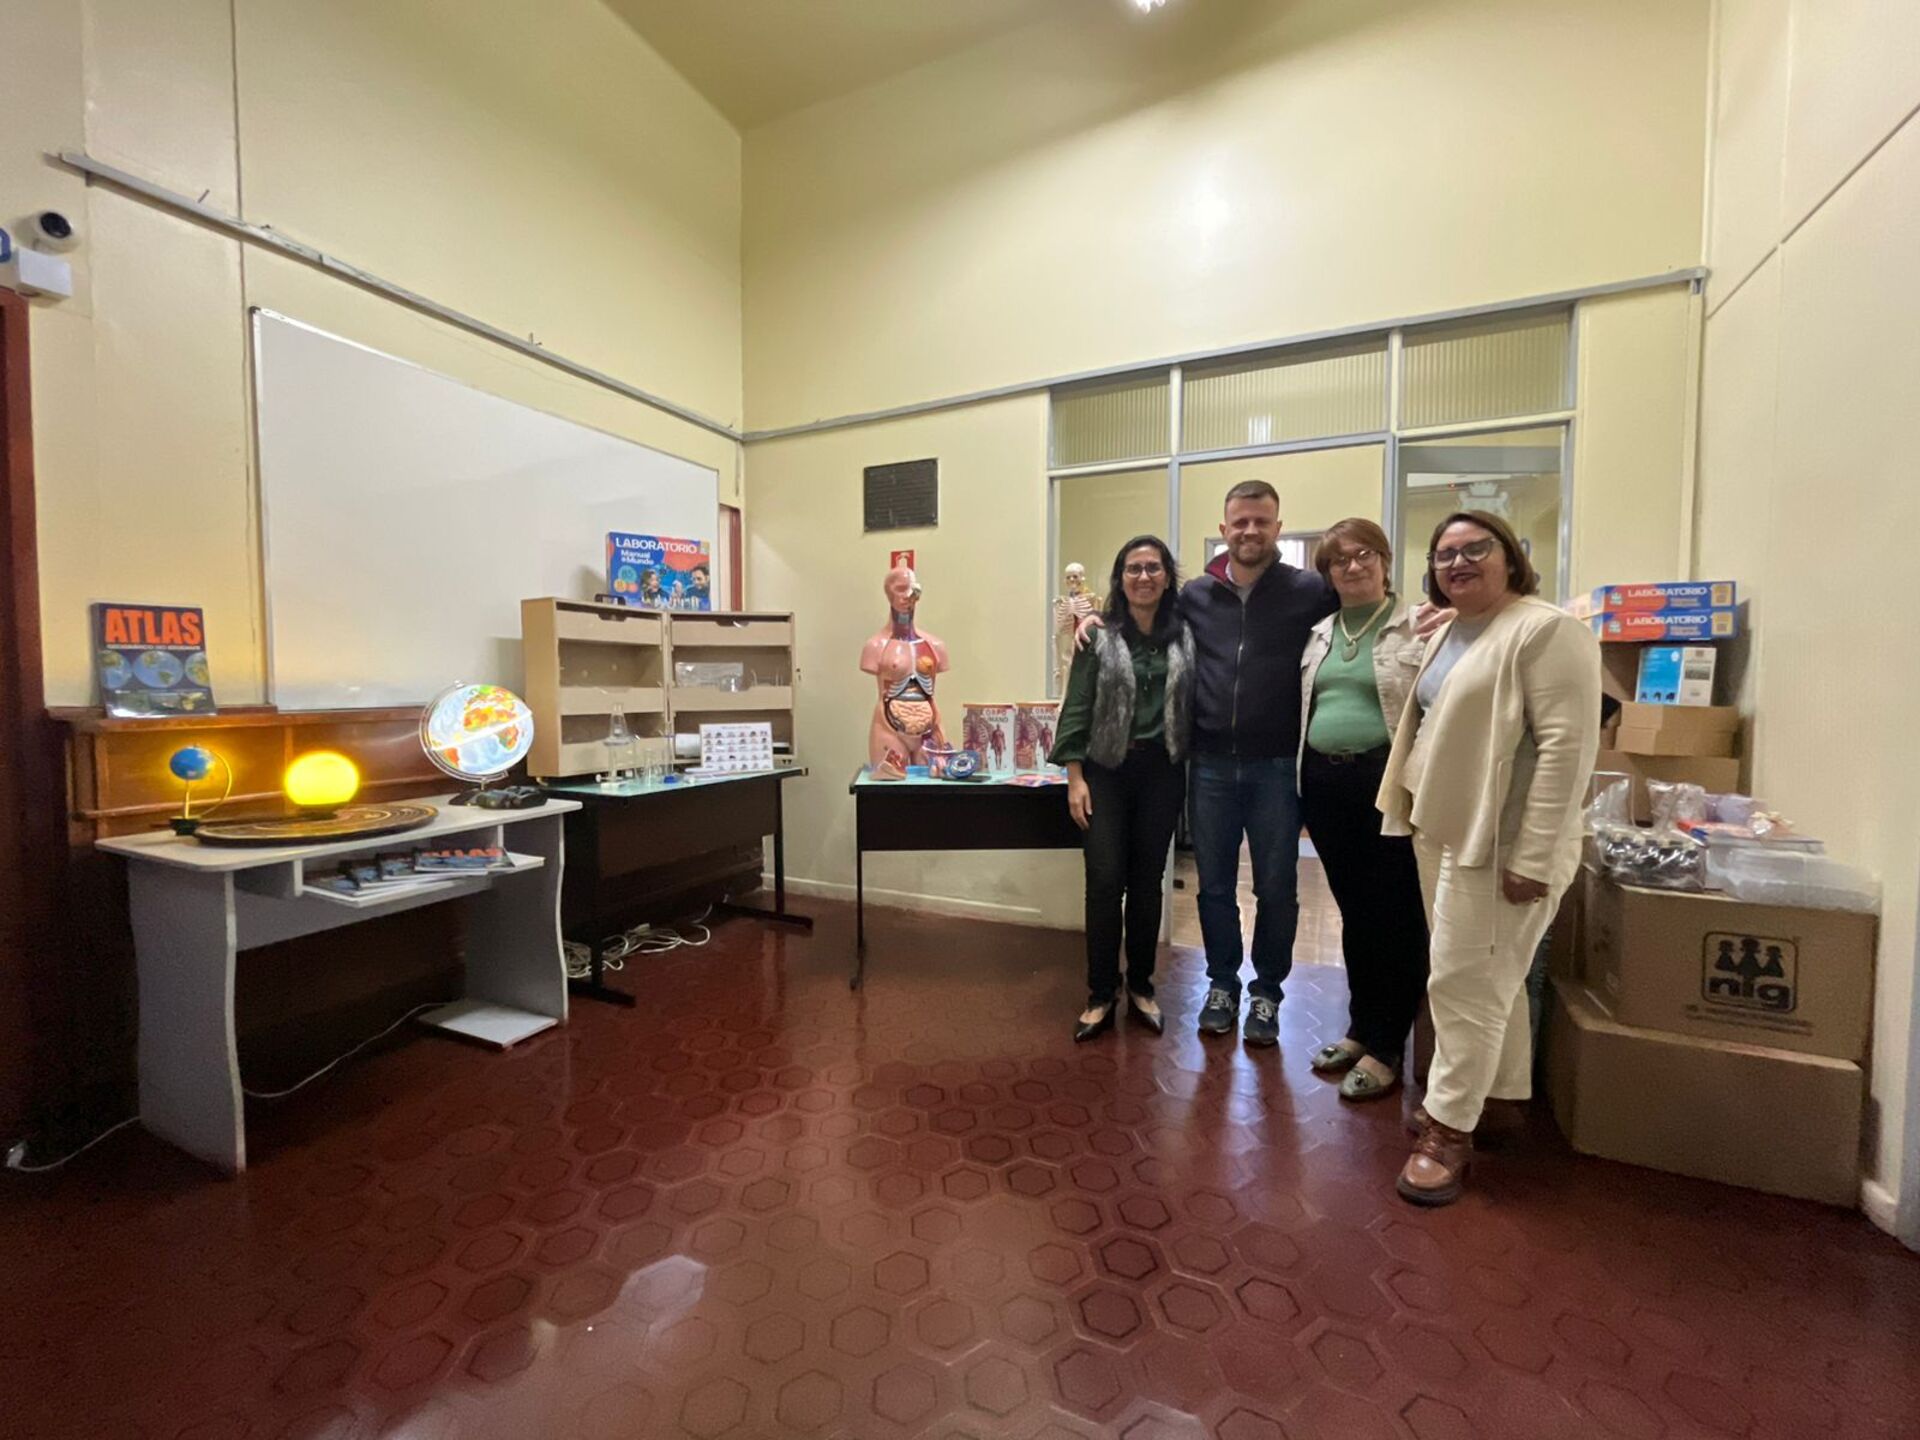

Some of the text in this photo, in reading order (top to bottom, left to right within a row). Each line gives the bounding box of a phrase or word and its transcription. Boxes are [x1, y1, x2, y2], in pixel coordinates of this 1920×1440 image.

[616, 537, 697, 554] LABORATORIO
[1628, 587, 1708, 599] LABORATORIO
[105, 608, 201, 645] ATLAS
[1627, 615, 1708, 626] LABORATORIO
